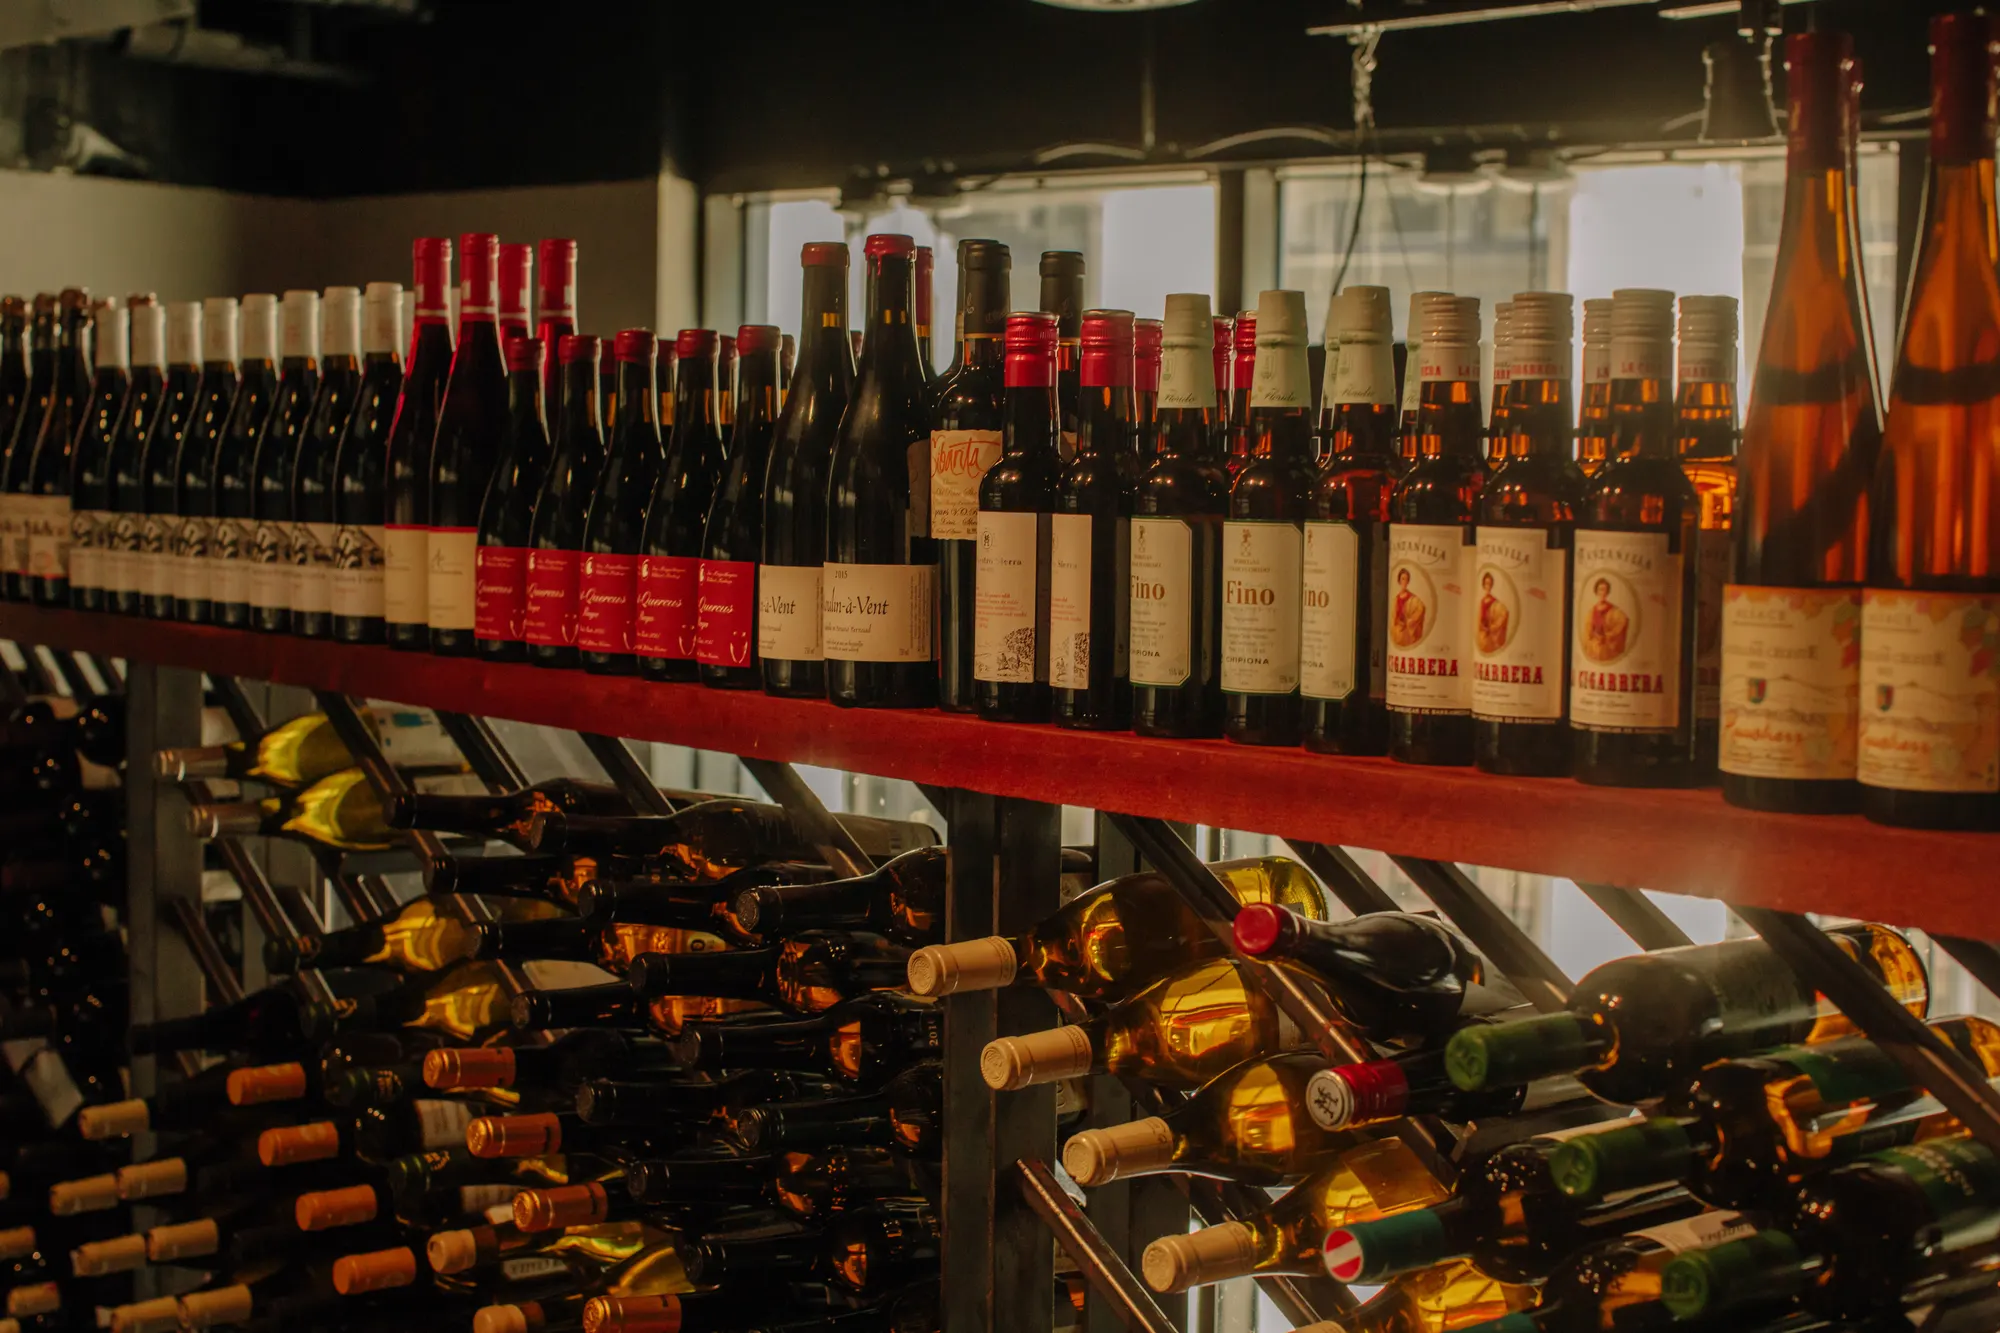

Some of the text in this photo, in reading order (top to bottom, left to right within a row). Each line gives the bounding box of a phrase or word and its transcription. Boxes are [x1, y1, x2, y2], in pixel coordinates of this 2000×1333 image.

[835, 570, 849, 580] 2015
[528, 582, 565, 600] Quercus
[586, 587, 627, 606] Quercus
[642, 590, 683, 609] Quercus
[1227, 580, 1276, 606] Fino
[698, 595, 734, 615] Quercus
